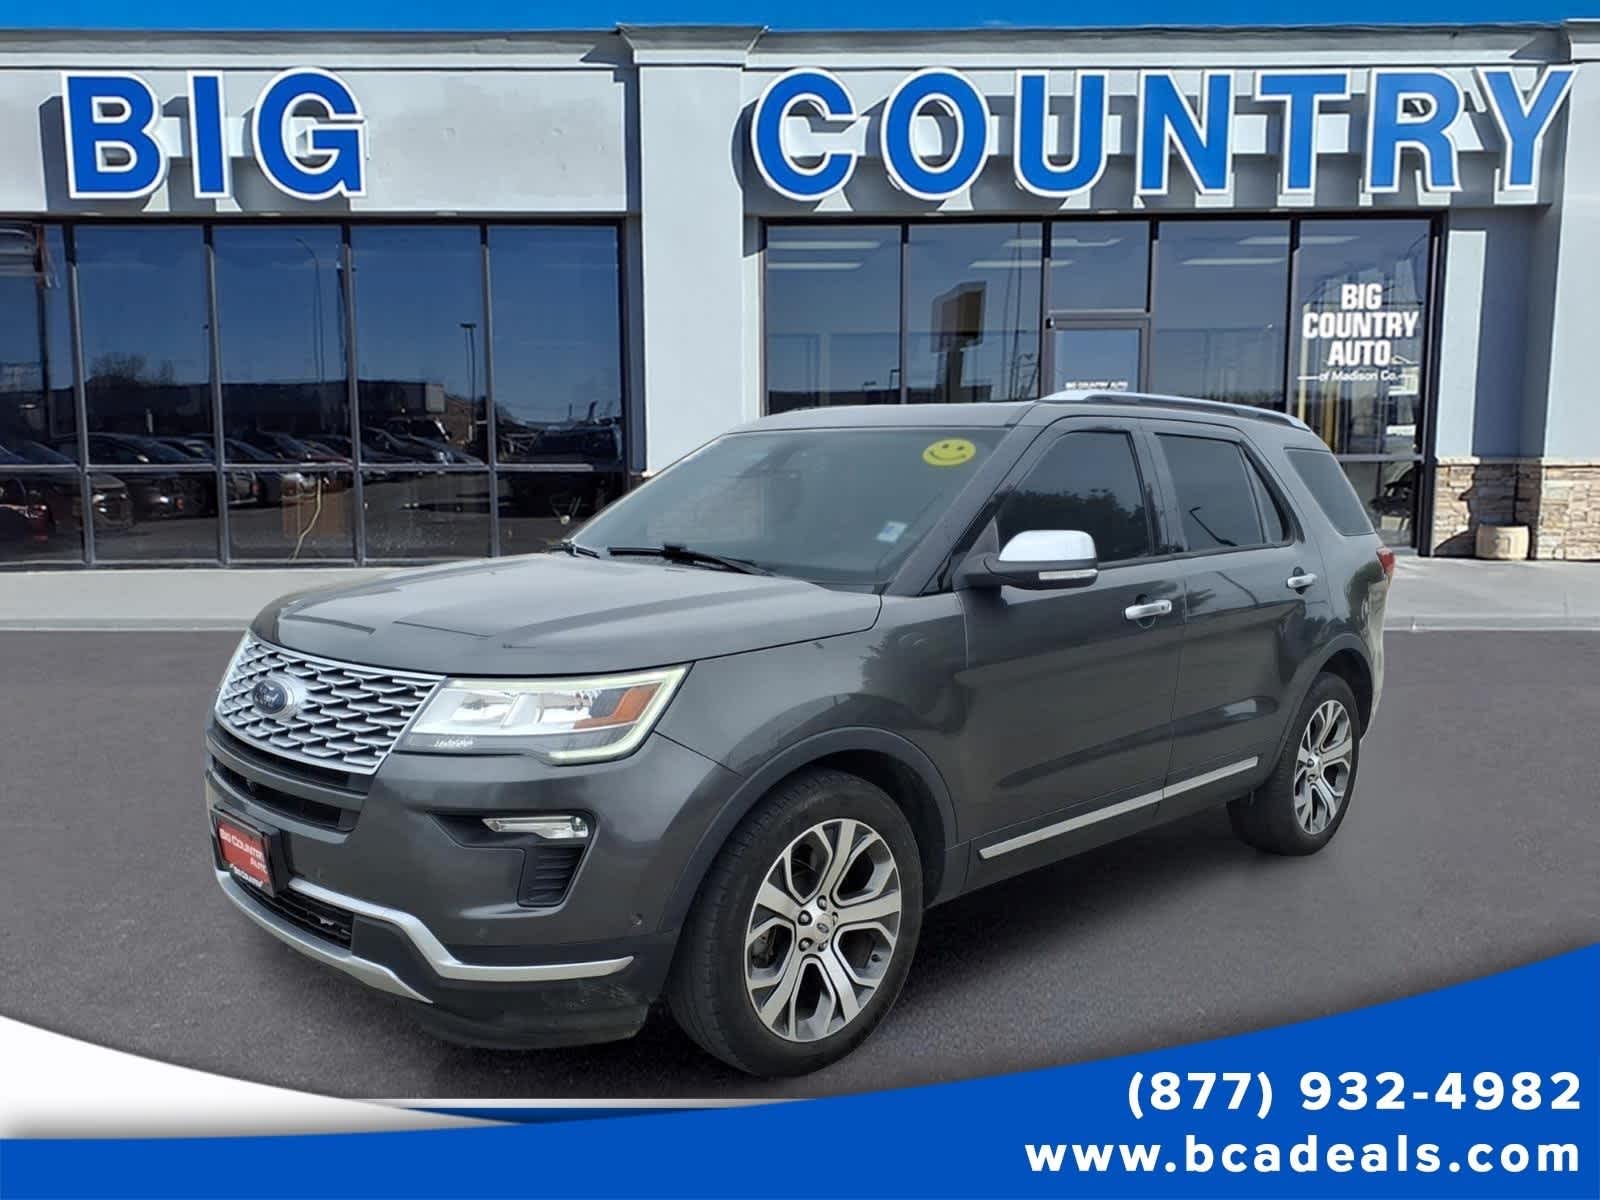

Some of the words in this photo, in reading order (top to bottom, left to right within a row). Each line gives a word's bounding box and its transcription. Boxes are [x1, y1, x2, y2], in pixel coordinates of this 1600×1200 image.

[61, 68, 366, 199] BIG
[751, 67, 1579, 202] COUNTRY
[1341, 283, 1382, 310] BIG
[1302, 311, 1419, 339] COUNTRY
[1327, 340, 1391, 366] AUTO
[1319, 370, 1330, 381] of
[1331, 370, 1378, 382] Madison
